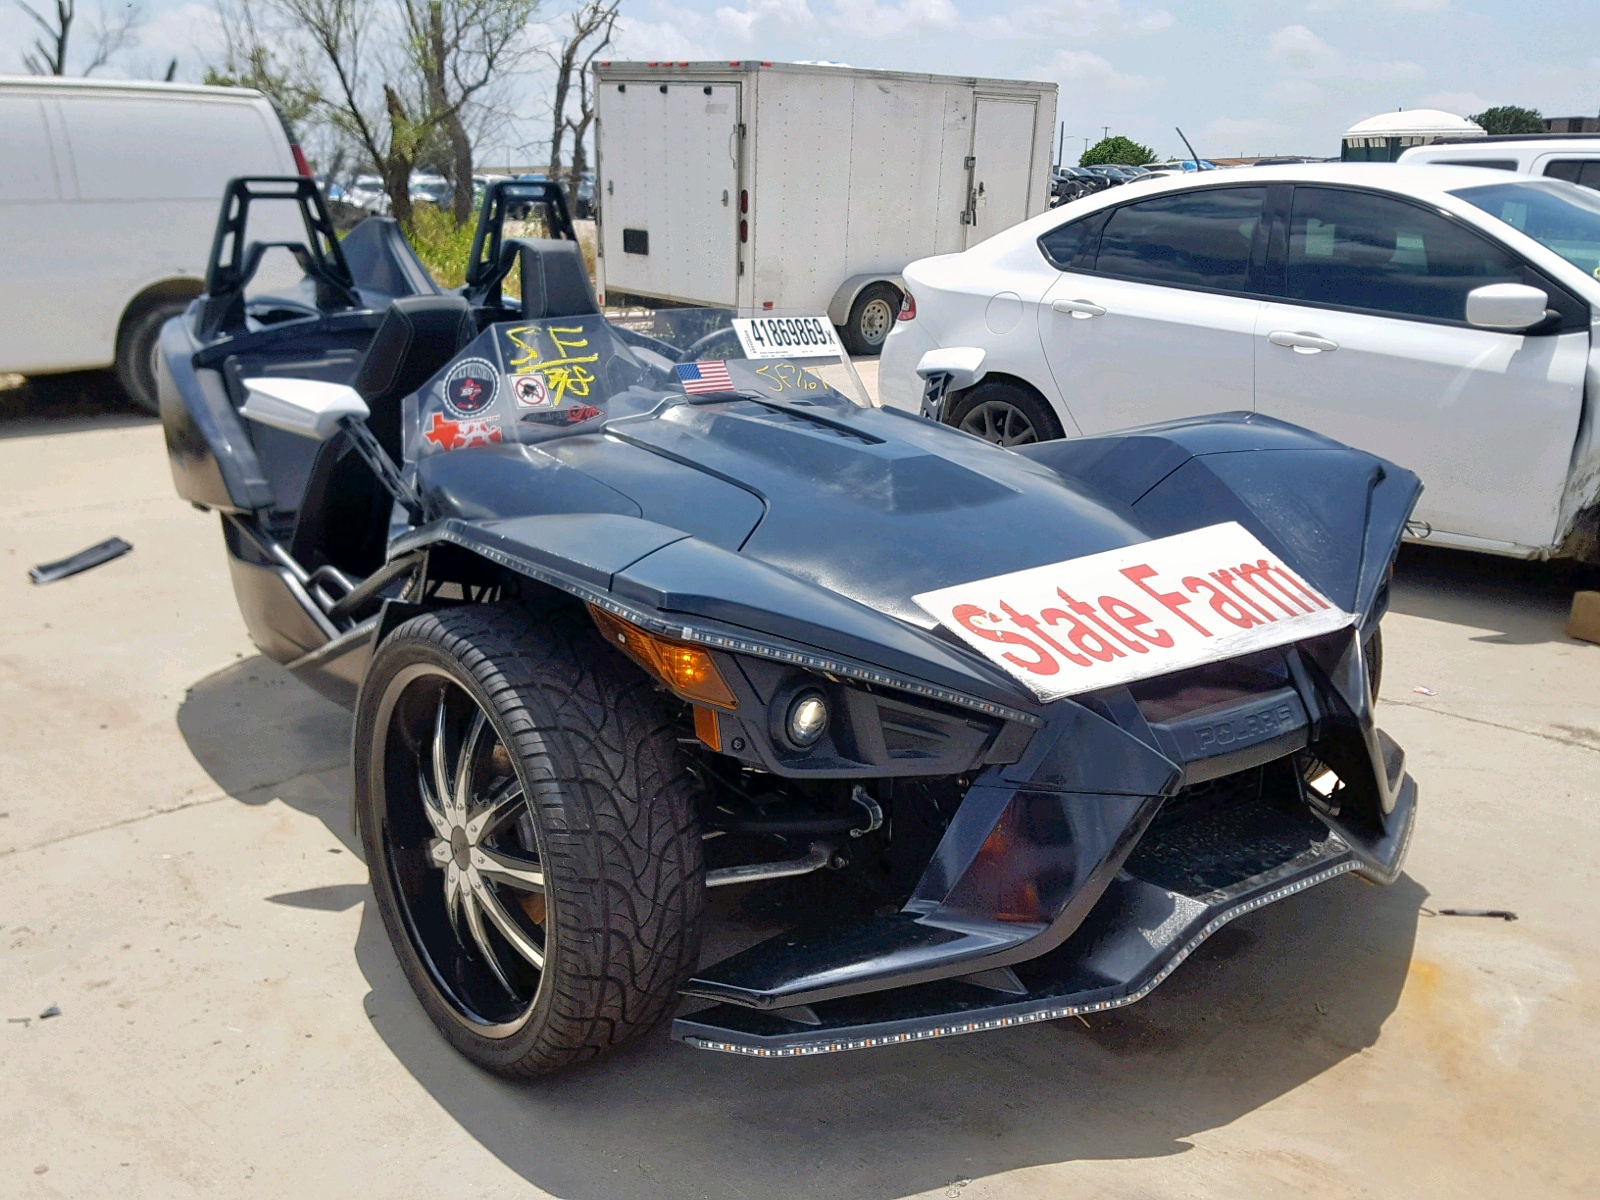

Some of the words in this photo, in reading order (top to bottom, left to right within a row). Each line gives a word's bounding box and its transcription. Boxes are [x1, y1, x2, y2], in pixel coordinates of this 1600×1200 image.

[750, 318, 827, 347] 41869869
[951, 586, 1175, 676] State
[1118, 559, 1333, 638] Farm
[1194, 704, 1292, 751] POLARIS
